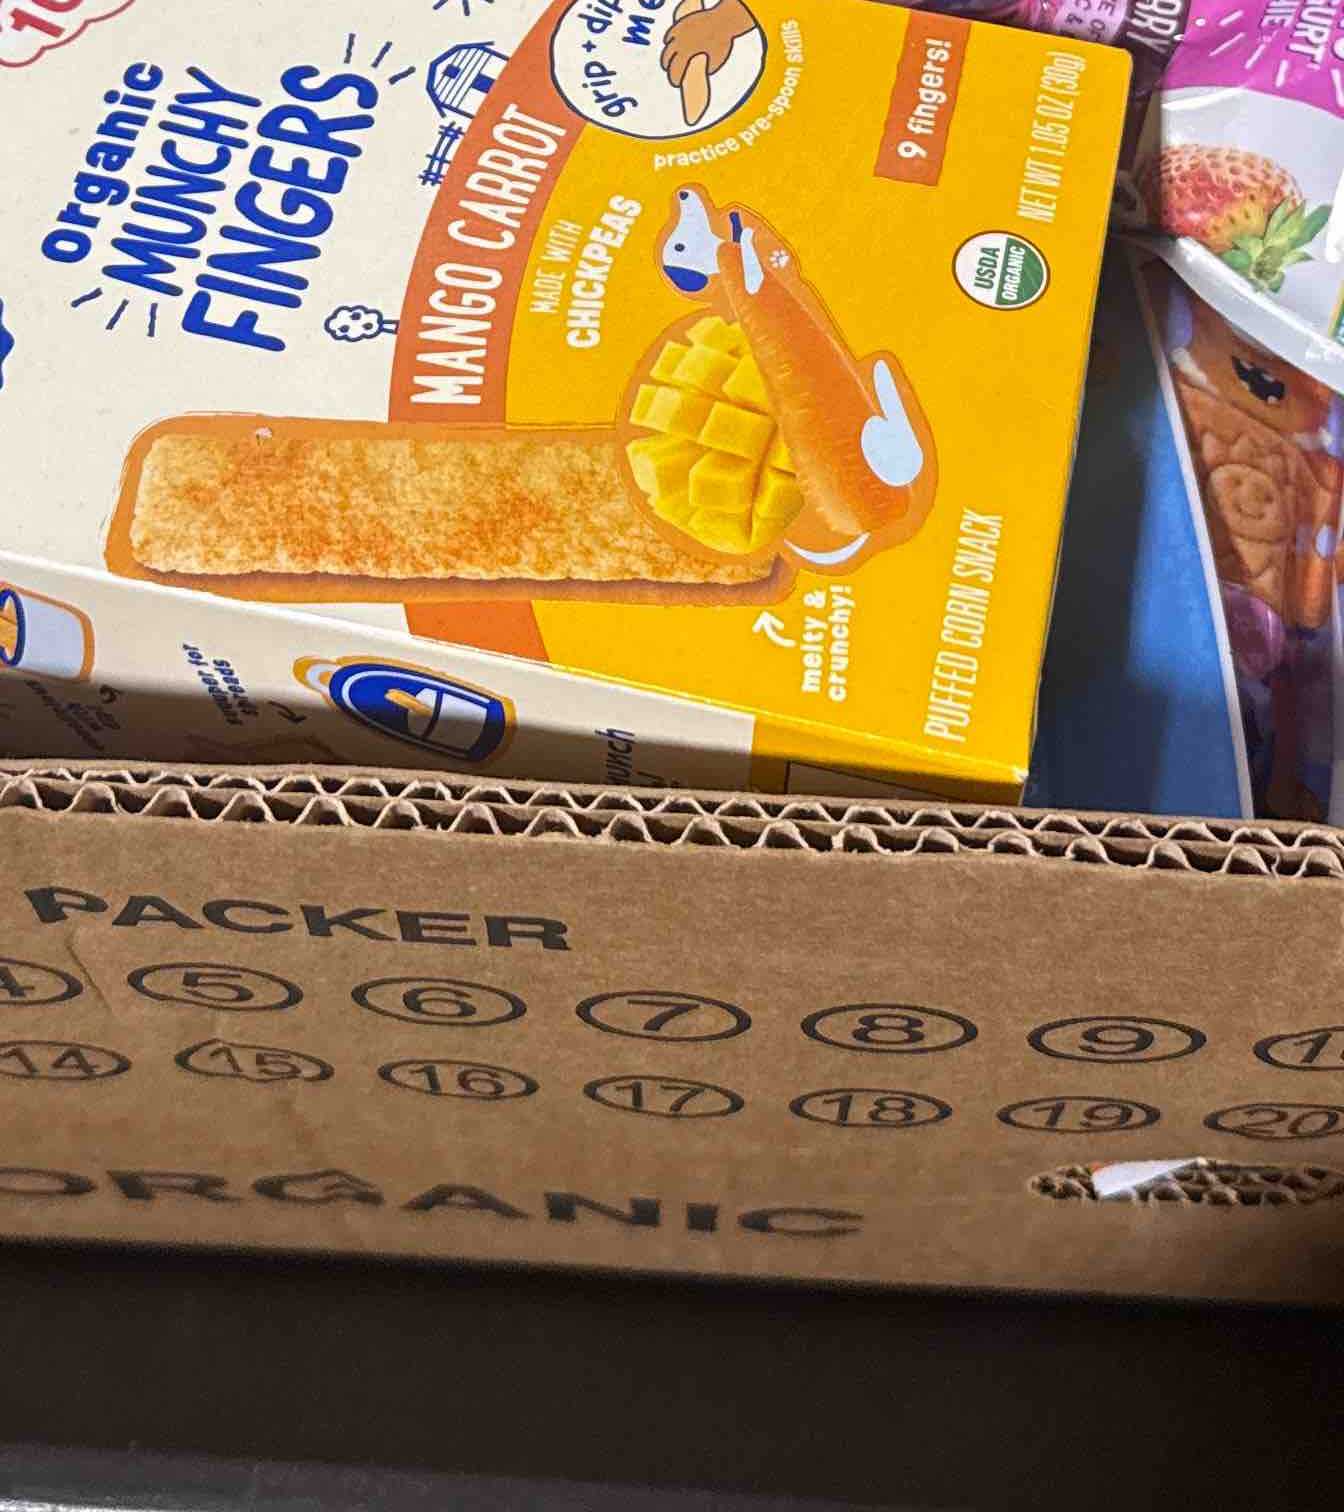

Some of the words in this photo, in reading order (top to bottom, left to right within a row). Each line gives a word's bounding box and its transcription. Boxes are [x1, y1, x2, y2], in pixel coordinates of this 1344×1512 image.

[582, 60, 639, 118] grip
[653, 138, 741, 172] practice
[741, 68, 803, 148] pre-spoon
[781, 18, 804, 66] skills
[906, 38, 953, 136] fingers!
[1035, 91, 1079, 120] OZ
[40, 61, 164, 265] organic
[897, 140, 927, 159] 9
[1023, 157, 1064, 187] WT
[1028, 119, 1071, 157] 1.05
[101, 66, 262, 297] MUNCHY
[181, 64, 379, 352] FINGERS
[448, 103, 567, 250] CARROT
[1016, 186, 1057, 224] NET
[541, 218, 583, 263] WITH
[567, 193, 643, 350] CHICKPEAS
[974, 246, 1000, 290] USDA
[1001, 245, 1027, 301] ORGANIC
[530, 260, 567, 314] MADE
[410, 261, 500, 406] MANGO
[953, 507, 1004, 584] SNACK
[804, 589, 826, 608] &
[940, 582, 991, 651] CORN
[800, 616, 828, 694] melty
[828, 585, 856, 703] crunchy!
[924, 649, 979, 743] PUFFED
[24, 887, 572, 952] PACKER
[1, 1044, 106, 1077] 14
[208, 1047, 306, 1080] 15
[411, 1064, 508, 1096] 16
[615, 1081, 716, 1115] 17
[822, 1092, 920, 1126] 18
[1032, 1100, 1133, 1132] 19
[1241, 1106, 1342, 1138] 20
